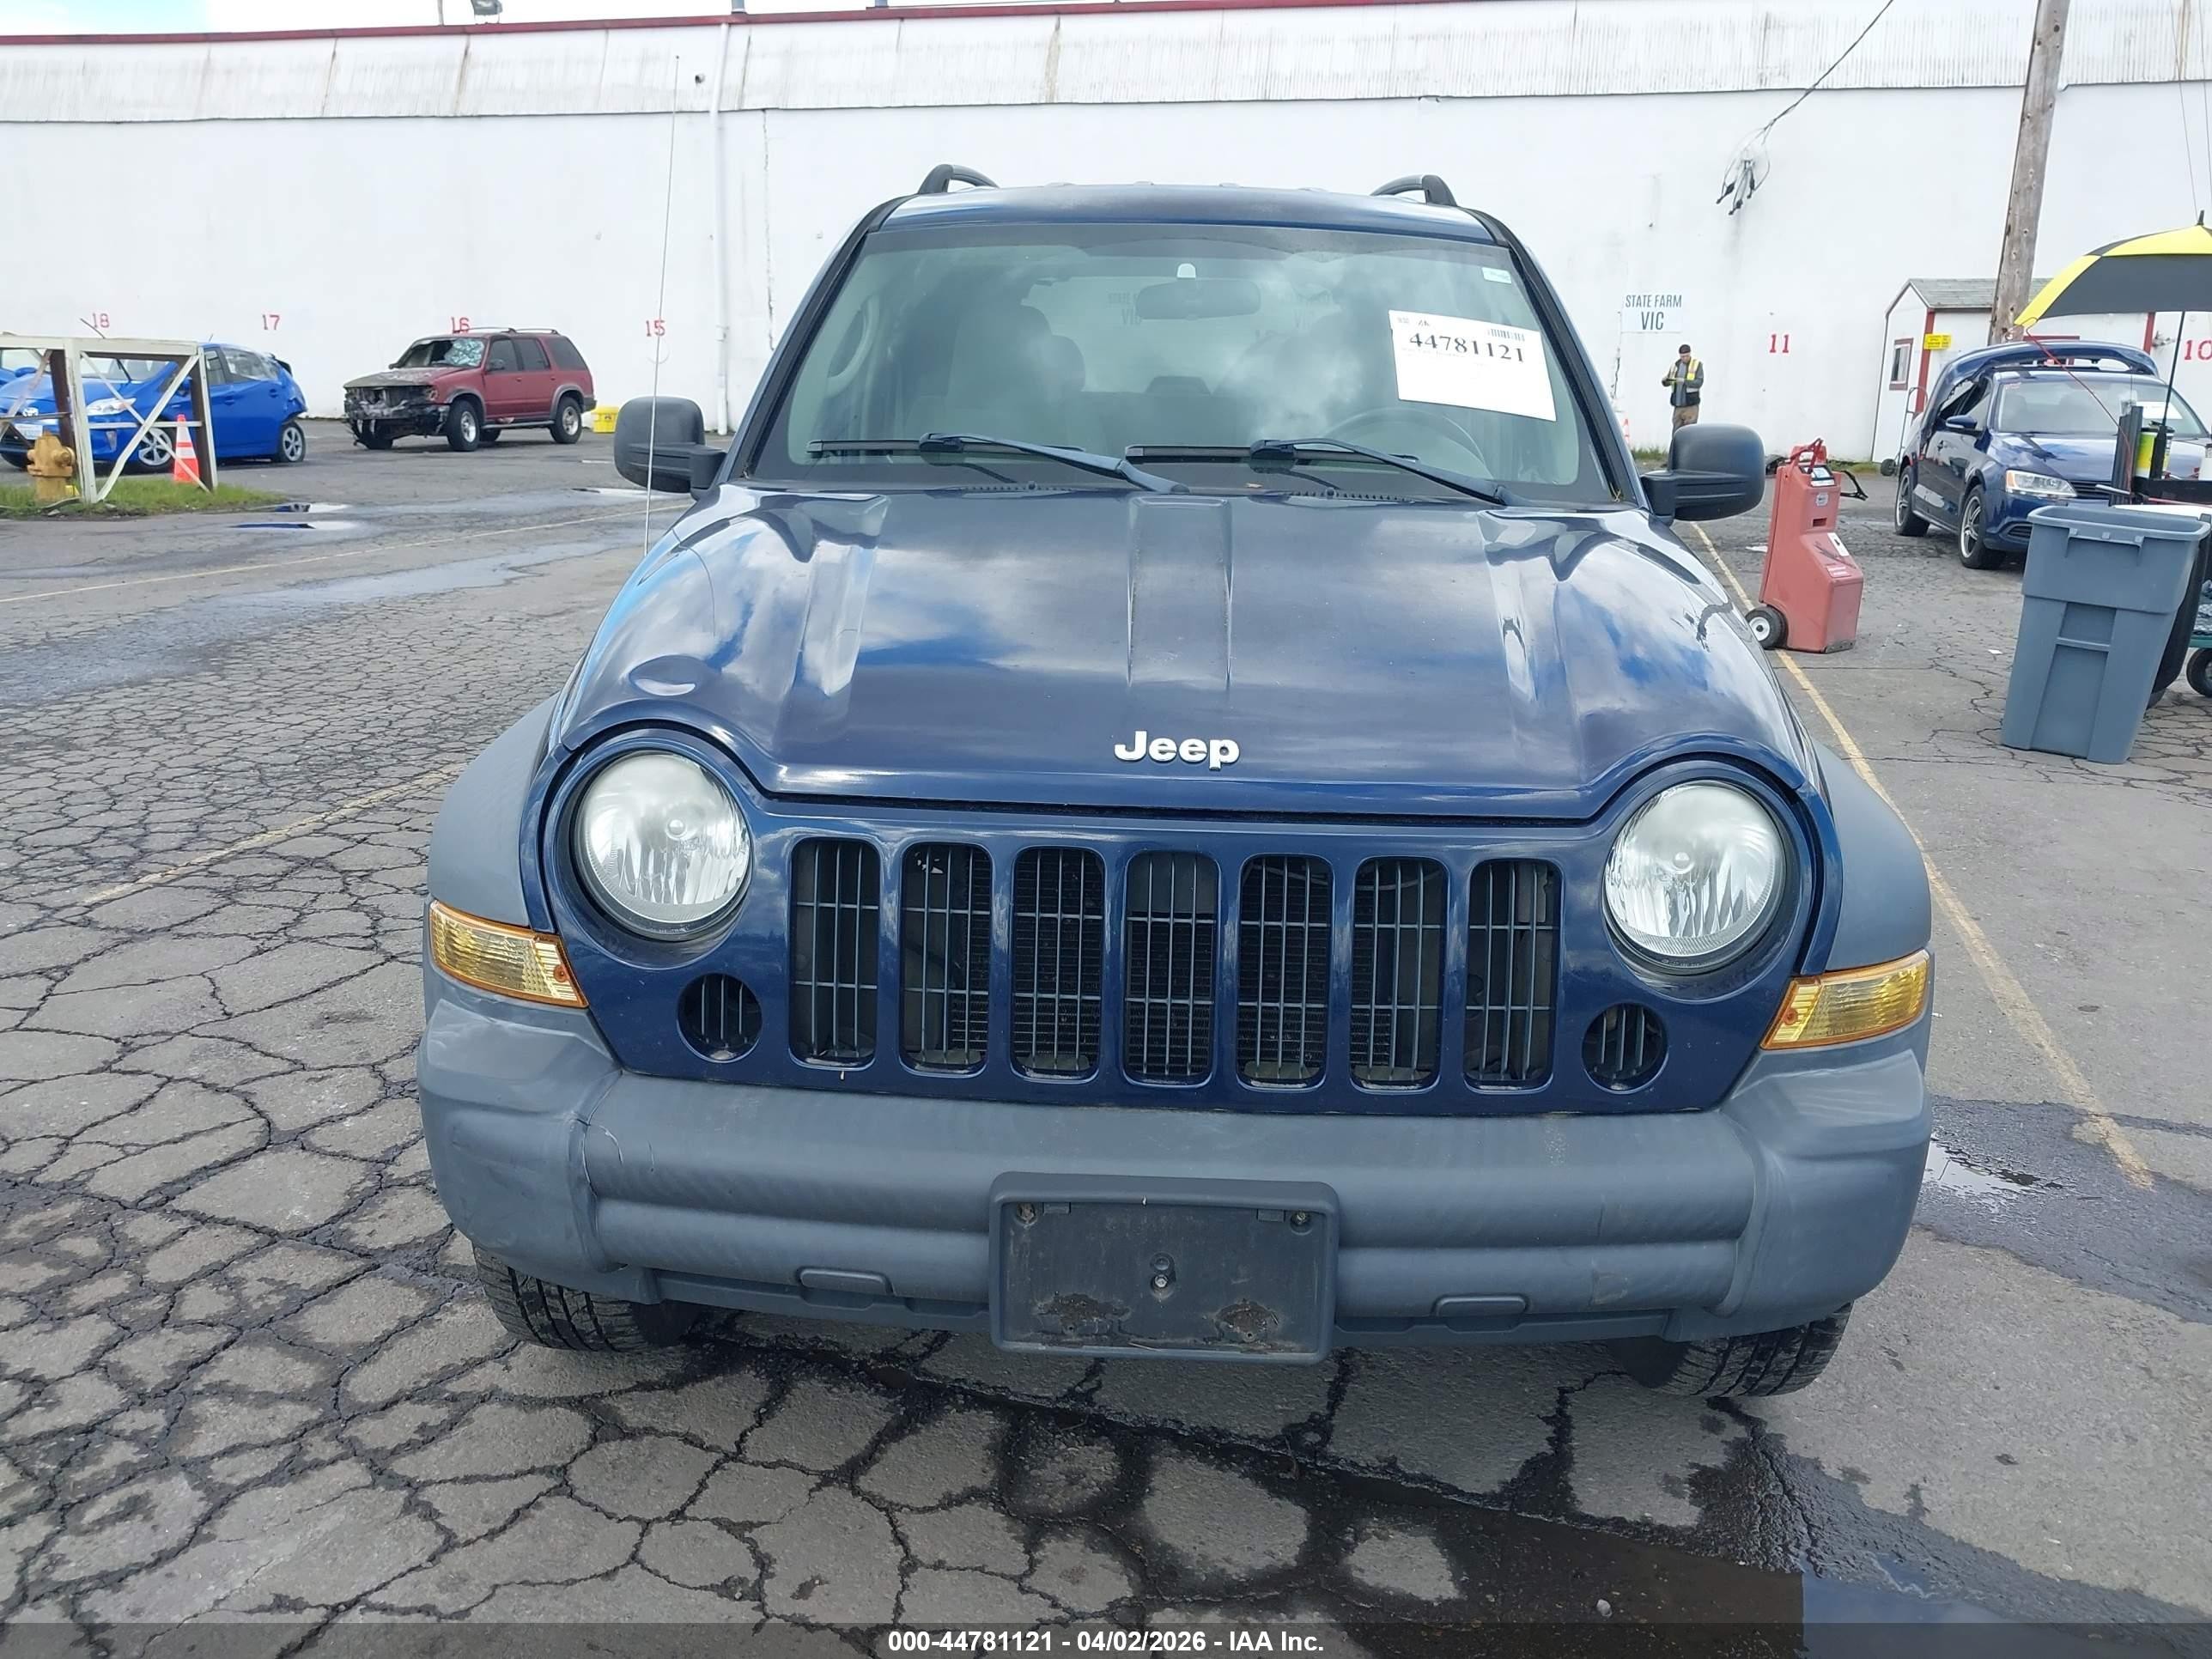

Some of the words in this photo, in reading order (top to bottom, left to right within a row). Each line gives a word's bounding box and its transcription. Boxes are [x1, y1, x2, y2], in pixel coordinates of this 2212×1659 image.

[1626, 295, 1651, 307] STATE
[1654, 295, 1682, 307] FARM
[92, 313, 110, 329] 18
[263, 314, 281, 331] 17
[451, 316, 470, 333] 16
[645, 320, 665, 337] 15
[1641, 311, 1664, 331] VIC
[1409, 332, 1524, 362] 44781121
[1769, 334, 1790, 354] 11
[1114, 730, 1240, 770] Jeep
